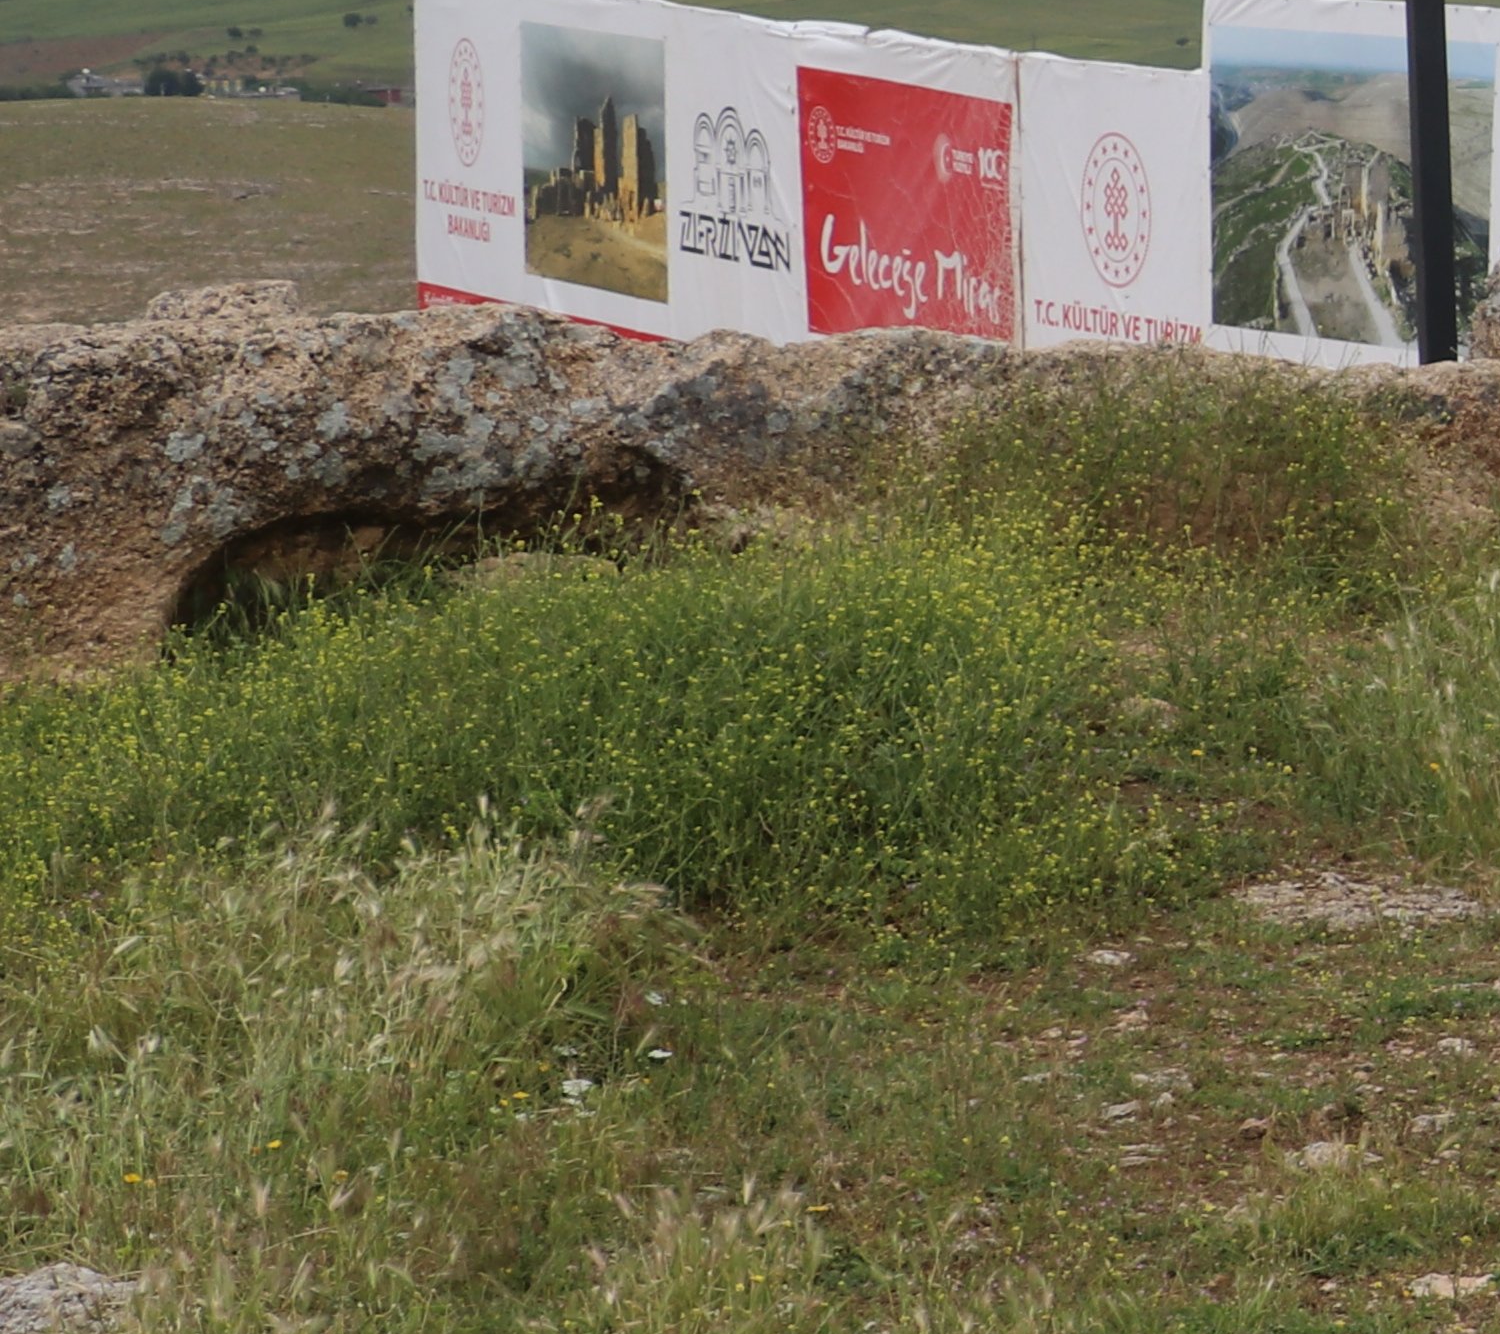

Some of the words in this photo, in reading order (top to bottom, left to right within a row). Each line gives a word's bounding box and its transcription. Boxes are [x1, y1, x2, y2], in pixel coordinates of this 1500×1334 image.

[439, 179, 469, 209] KÜLTÜR
[469, 191, 481, 211] VE
[481, 190, 516, 216] TURİZM
[447, 214, 491, 242] BAKANLIĞI
[1034, 299, 1059, 327] T.C.
[1062, 300, 1119, 337] KÜLTÜR
[1121, 314, 1141, 341] VE
